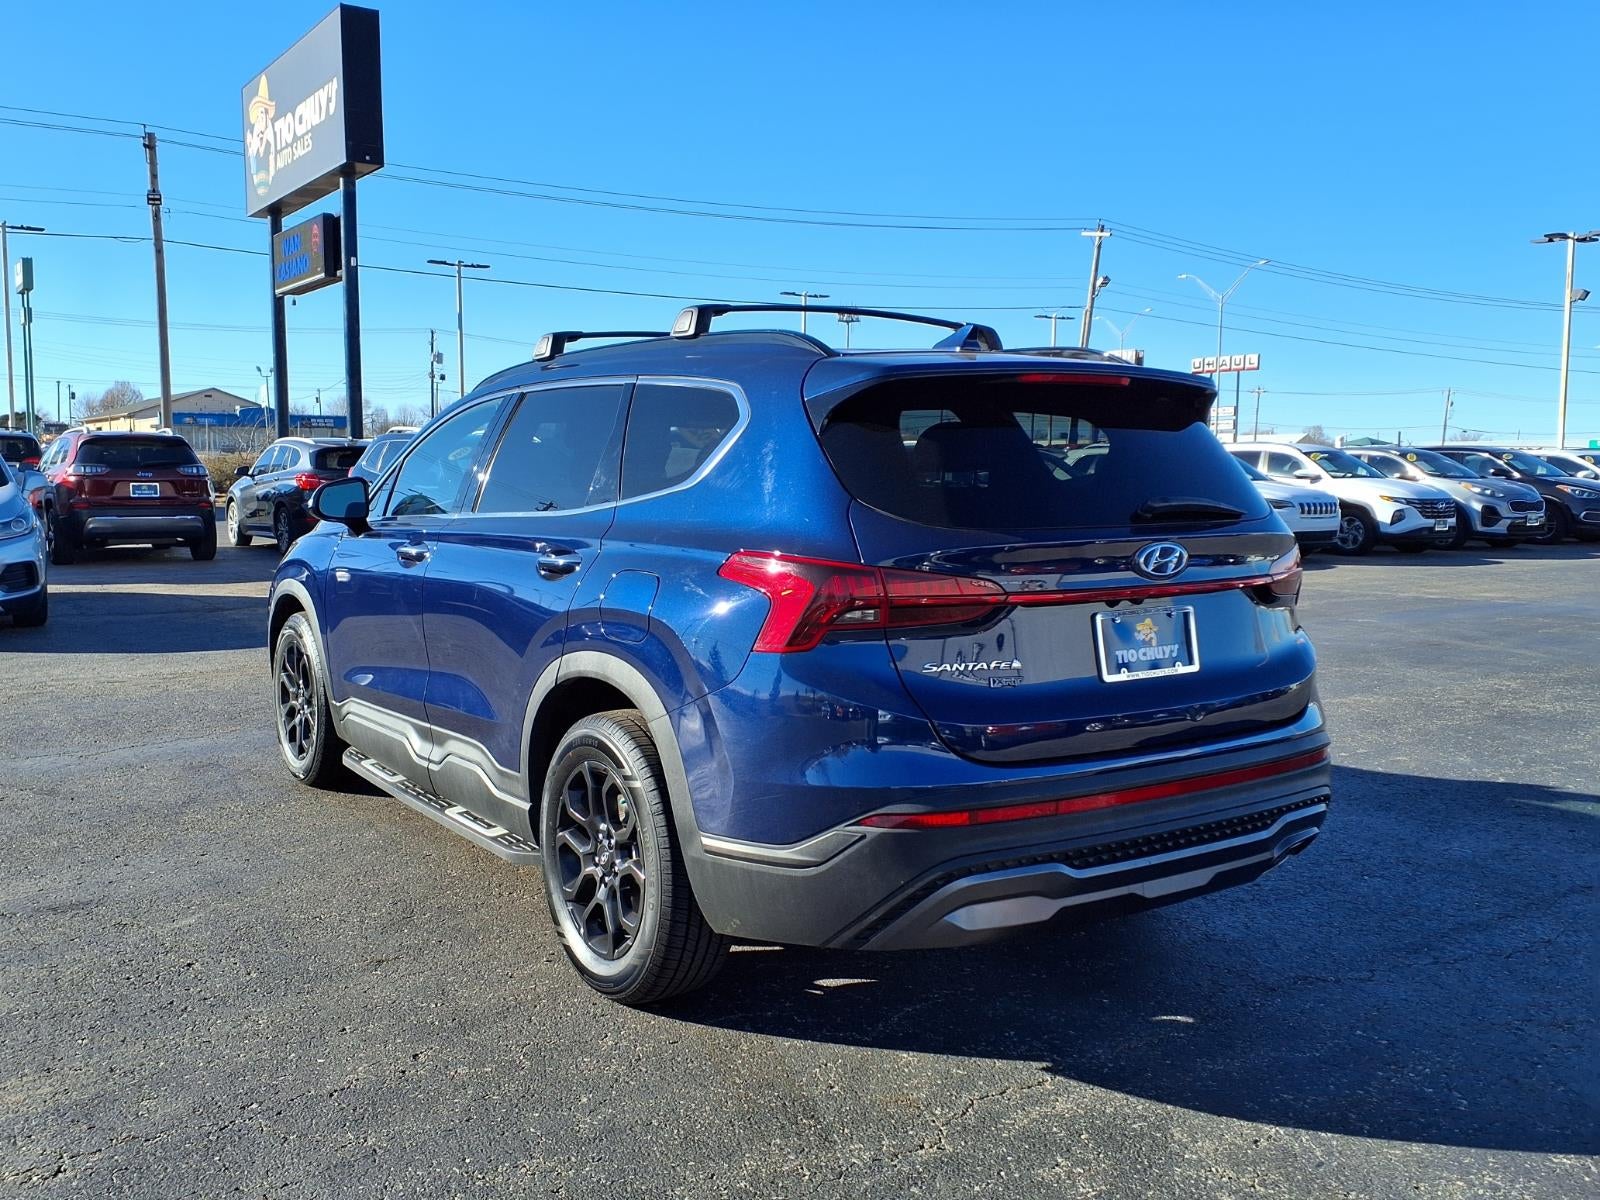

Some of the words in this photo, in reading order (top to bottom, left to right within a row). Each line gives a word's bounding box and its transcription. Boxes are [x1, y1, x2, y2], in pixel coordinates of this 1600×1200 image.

[274, 112, 294, 151] TIO
[295, 76, 338, 137] CHUY'S
[276, 147, 292, 171] AUTO
[293, 132, 312, 160] SALES
[1115, 649, 1138, 664] TIO
[1138, 644, 1179, 661] CHUY'S
